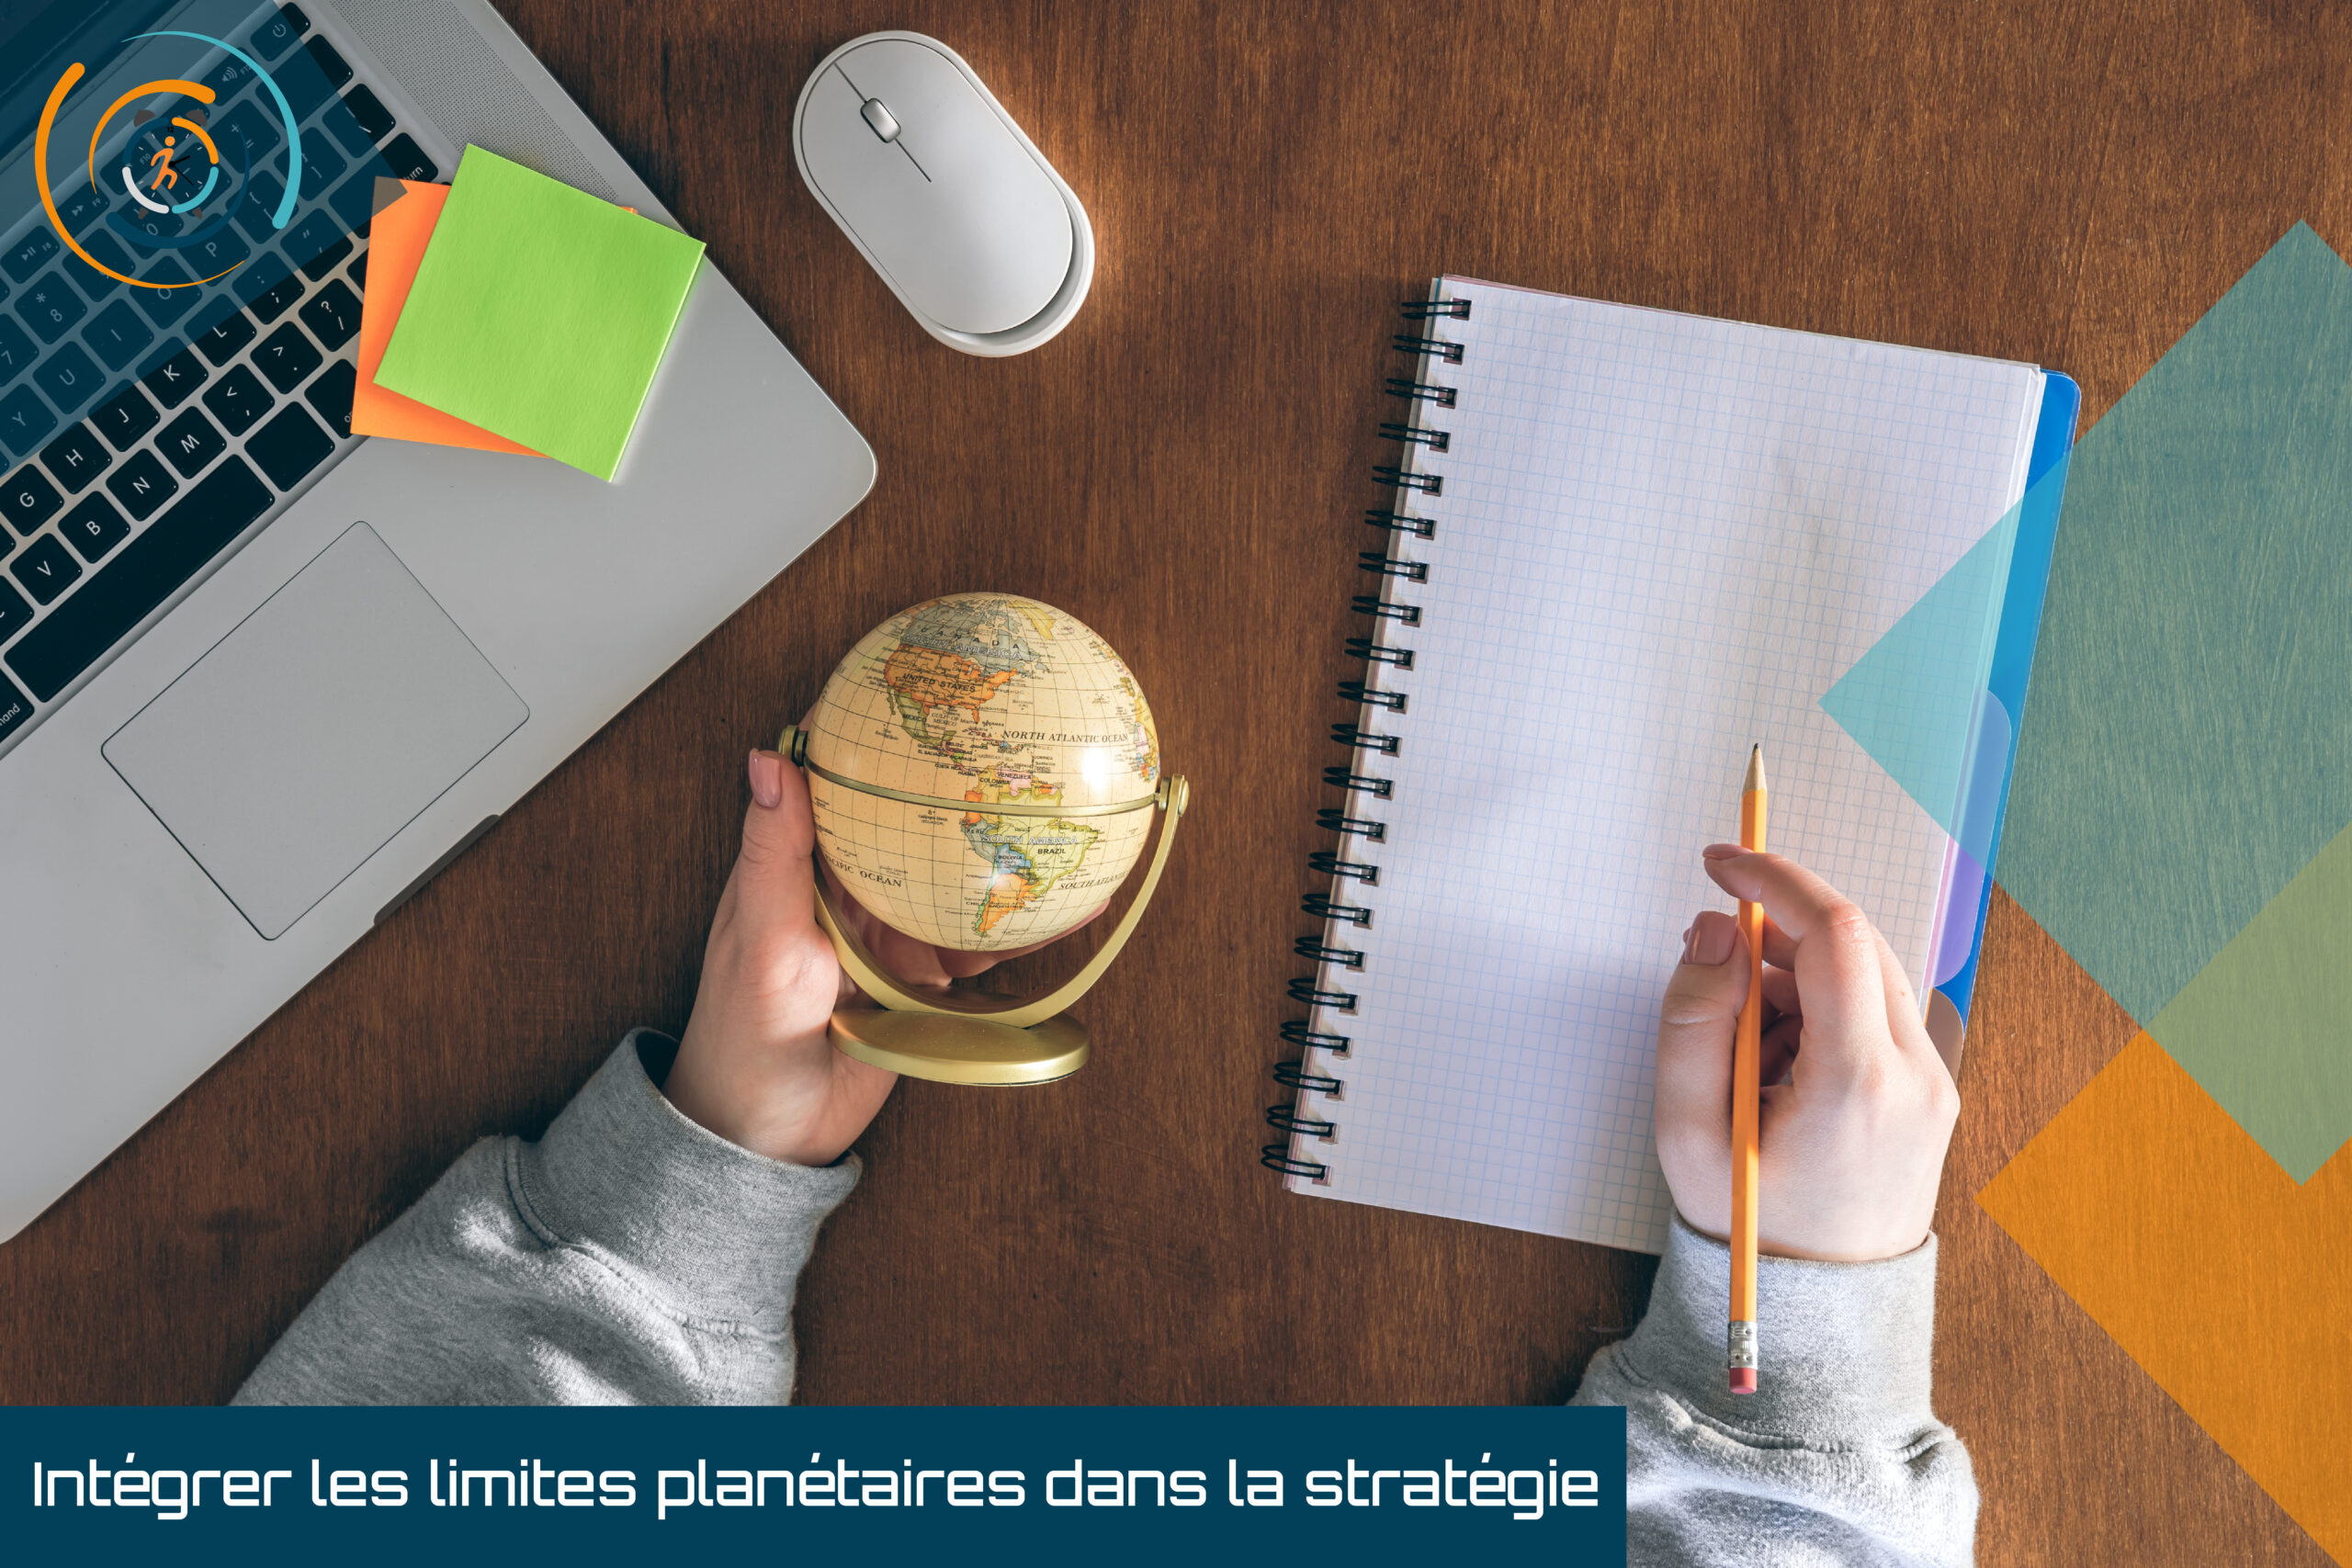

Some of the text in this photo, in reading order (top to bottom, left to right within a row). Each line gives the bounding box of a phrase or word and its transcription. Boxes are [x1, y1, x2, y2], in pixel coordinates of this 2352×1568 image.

[205, 242, 218, 257] P
[50, 309, 62, 321] 8
[212, 325, 227, 338] L
[59, 368, 75, 386] U
[163, 364, 180, 382] K
[12, 411, 26, 426] Y
[119, 408, 130, 423] J
[180, 434, 200, 454] M
[65, 448, 84, 467] H
[132, 476, 151, 494] N
[19, 491, 35, 507] G
[85, 520, 101, 536] B
[37, 560, 51, 576] V
[921, 626, 1020, 649] CANADA
[903, 672, 935, 685] UNITED
[940, 681, 976, 693] STATES
[903, 714, 927, 722] MEXICO
[1001, 730, 1129, 743] NORTH ATLANTIC OCEAN
[997, 772, 1032, 780] VENEZUELA
[982, 834, 1023, 844] SOUTH
[859, 870, 902, 887] OCEAN
[1060, 879, 1093, 889] SOUTH
